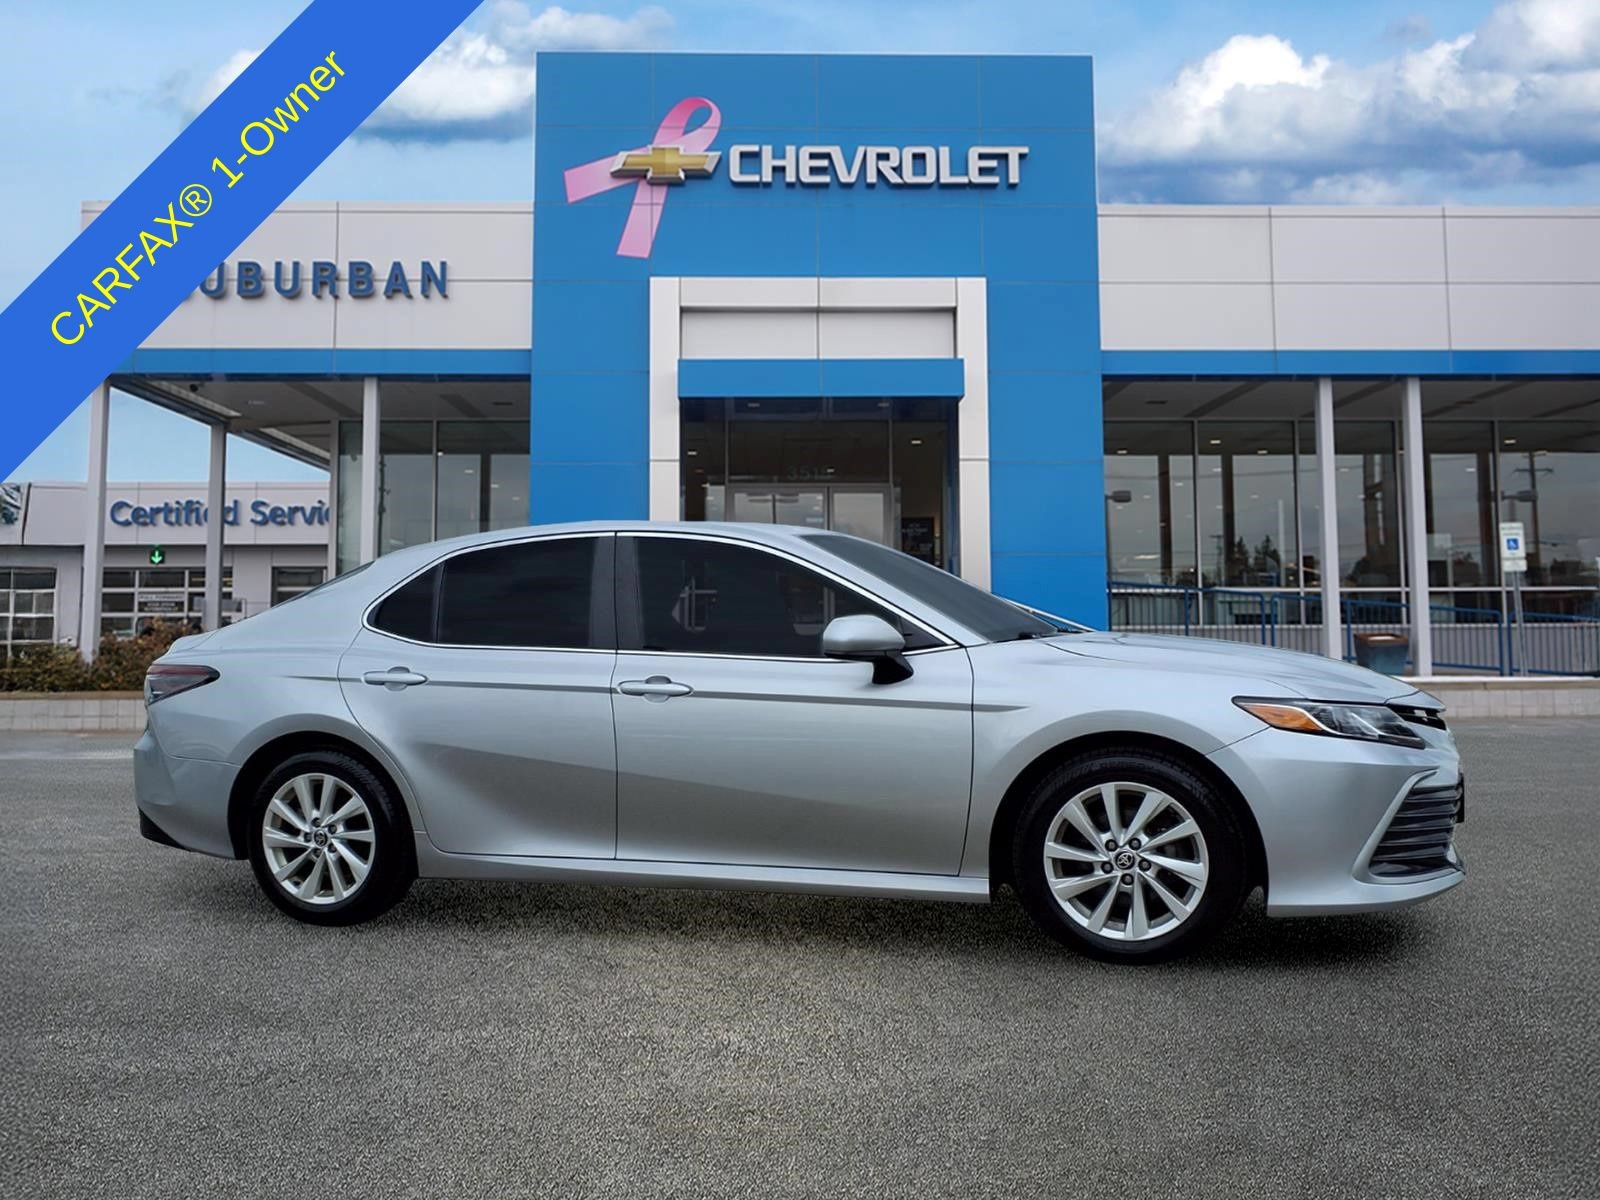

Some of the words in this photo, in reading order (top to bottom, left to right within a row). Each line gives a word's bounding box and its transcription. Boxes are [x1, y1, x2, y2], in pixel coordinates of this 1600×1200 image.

[729, 144, 1029, 187] CHEVROLET
[198, 261, 449, 299] UBURBAN
[110, 499, 241, 527] Certifid
